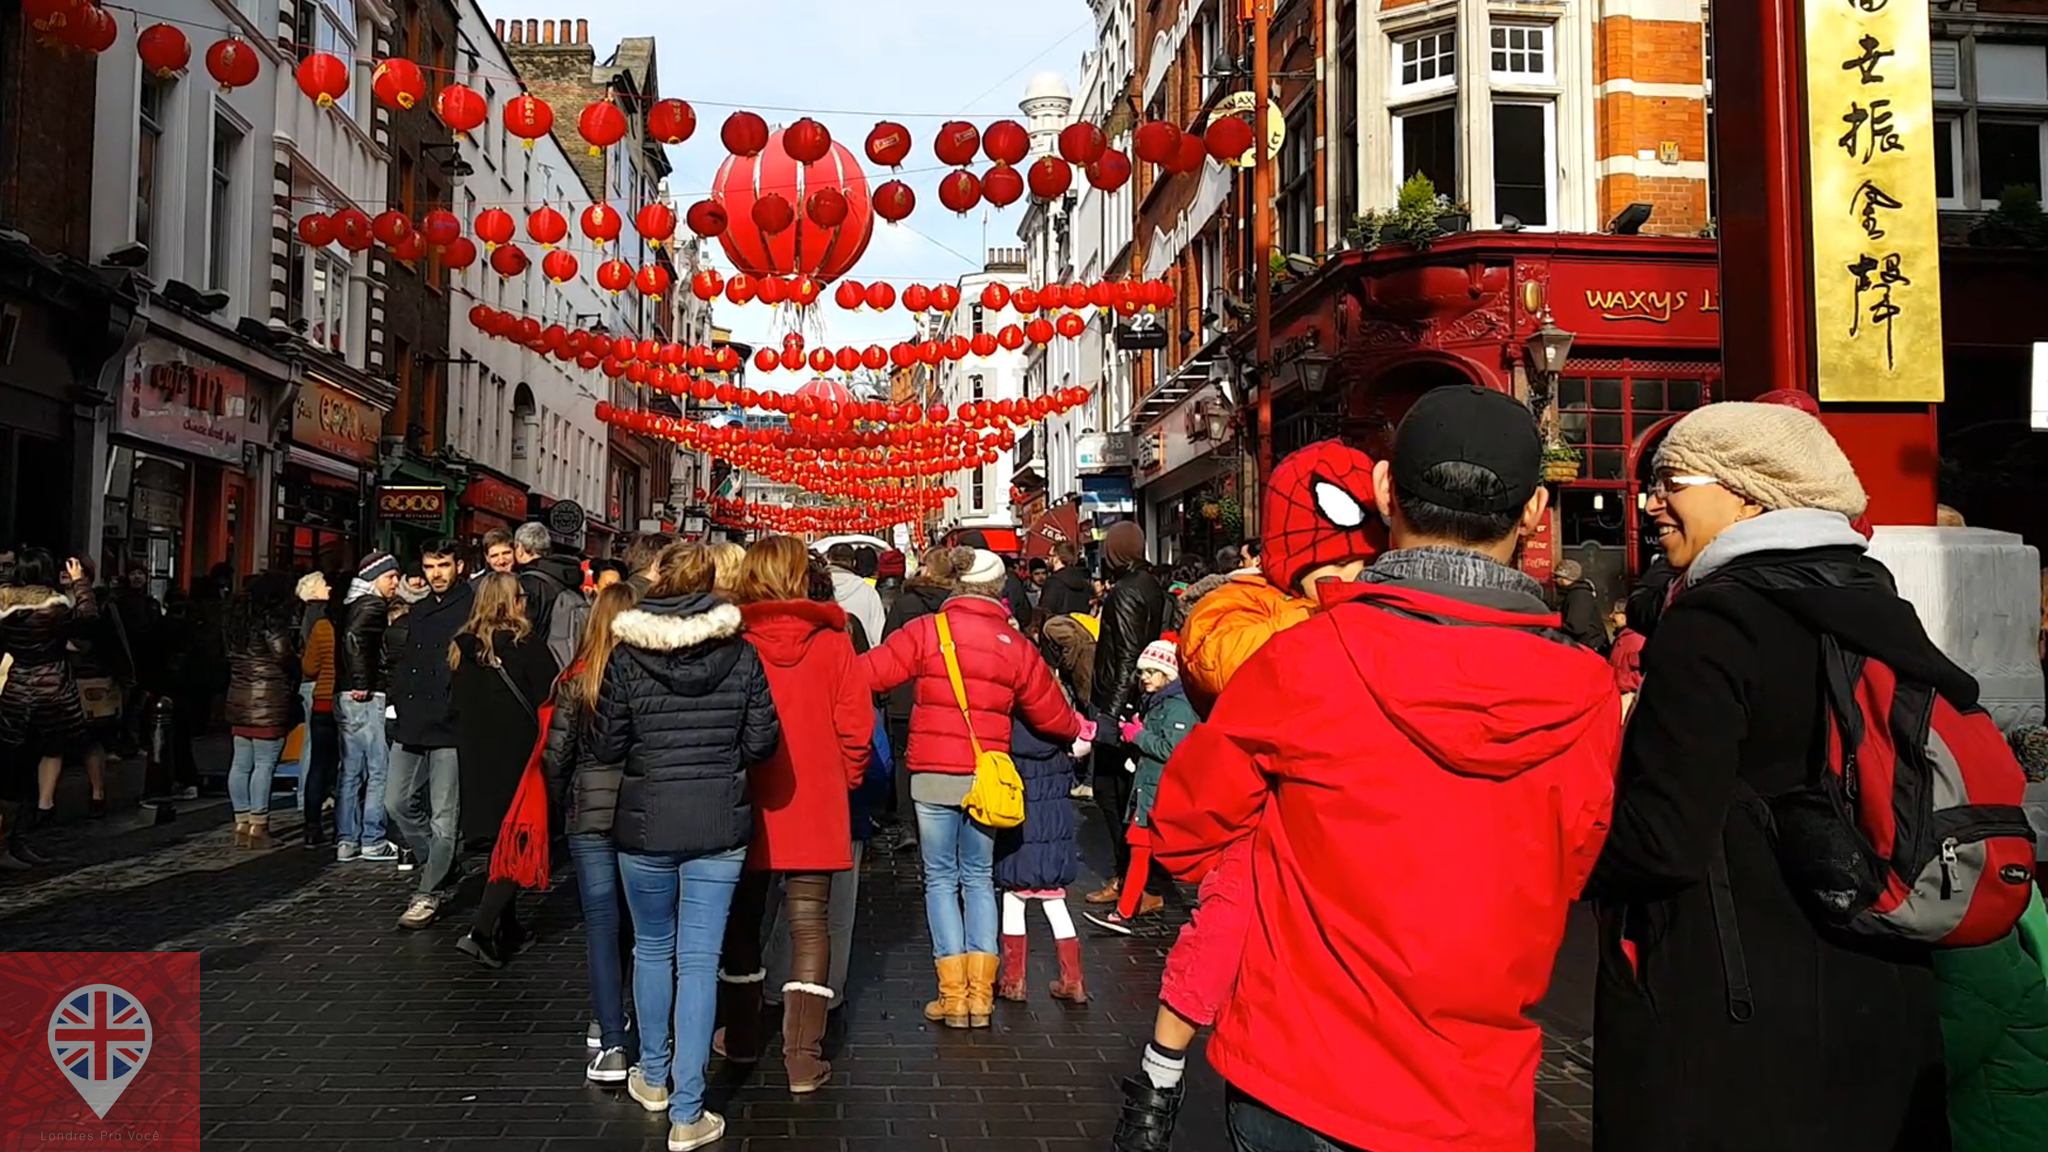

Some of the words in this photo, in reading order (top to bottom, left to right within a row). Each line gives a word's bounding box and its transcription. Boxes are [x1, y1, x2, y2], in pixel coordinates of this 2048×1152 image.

[1838, 0, 1911, 371] 世振金聲
[1699, 289, 1720, 312] L
[1130, 313, 1155, 331] 22
[249, 396, 262, 425] 21
